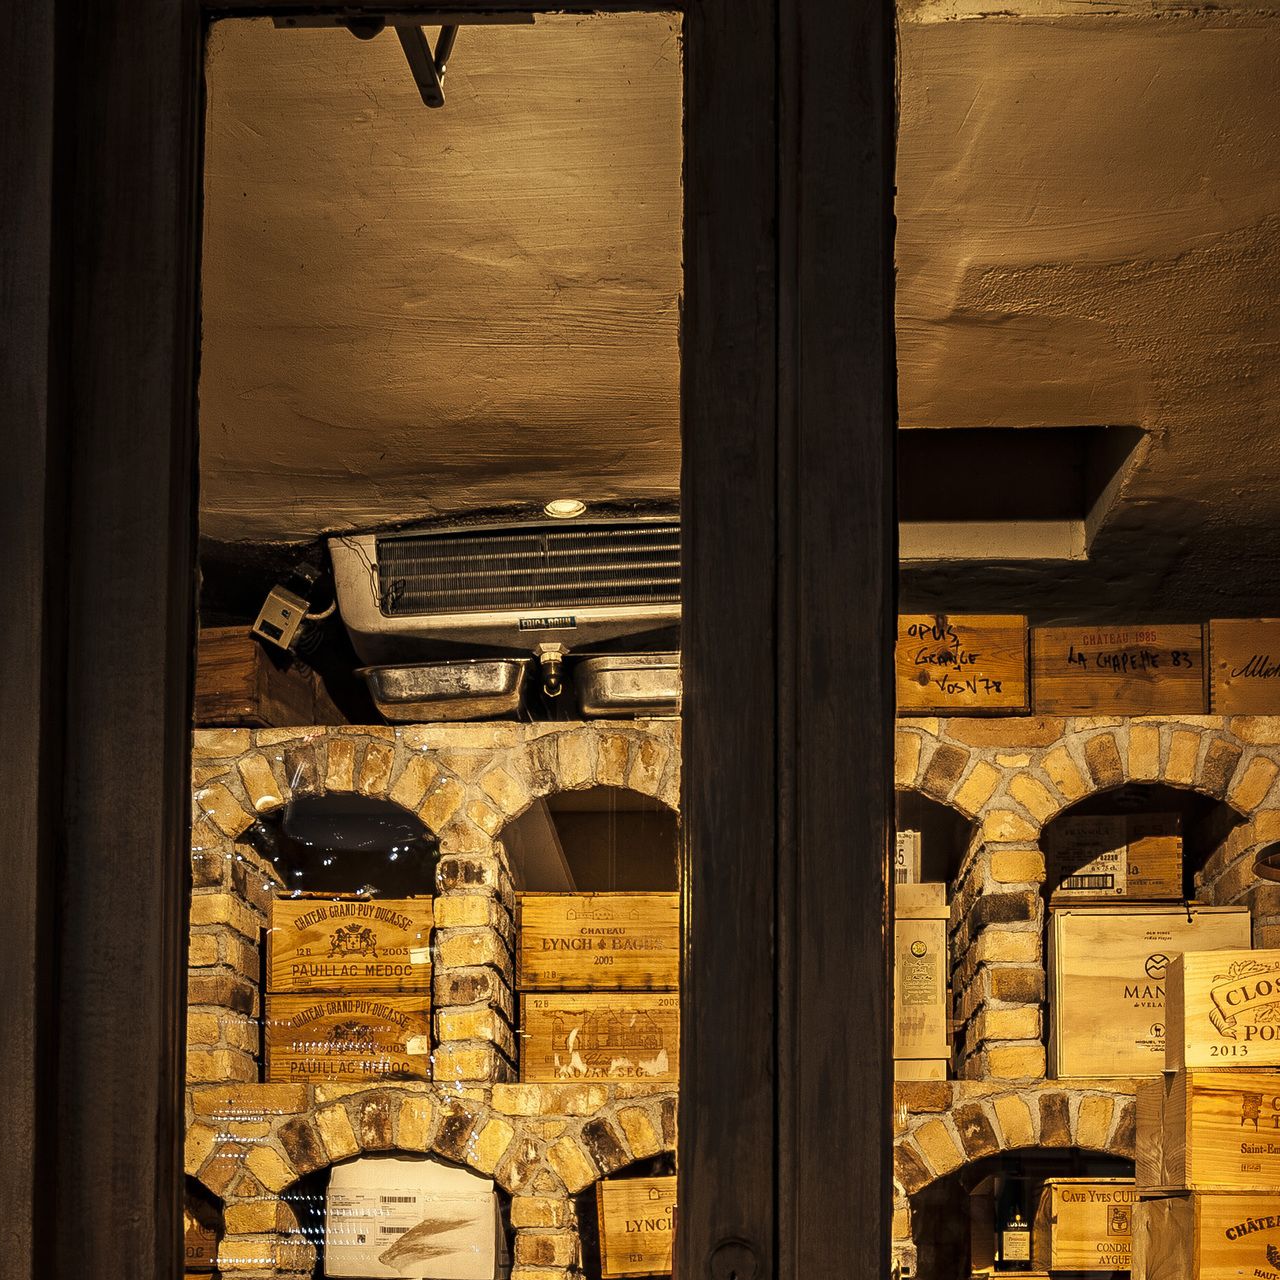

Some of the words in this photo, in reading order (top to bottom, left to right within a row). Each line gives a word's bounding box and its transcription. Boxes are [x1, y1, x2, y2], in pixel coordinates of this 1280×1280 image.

[907, 624, 959, 642] OPUS
[1083, 633, 1129, 646] CHATEAU
[1135, 631, 1157, 642] 1985
[1068, 645, 1088, 670] LA
[1171, 650, 1193, 669] 83
[294, 907, 328, 932] CHATEAU
[329, 904, 356, 918] GRAND
[358, 903, 375, 917] PUY
[375, 906, 413, 932] DUCASSE
[580, 927, 626, 935] CHATEAU
[542, 938, 592, 950] LYNCH
[593, 955, 614, 965] 2003
[292, 964, 358, 977] PAUILLAC
[365, 964, 413, 977] MEDOC
[292, 1004, 324, 1029] CHATEAU
[327, 1001, 353, 1015] GRAND
[355, 1000, 372, 1013] PUY
[372, 1003, 411, 1029] DUCASSE
[1210, 1045, 1249, 1057] 2013
[290, 1061, 355, 1074] PAUILLAC
[363, 1061, 410, 1074] MEDOC
[1098, 1255, 1132, 1264] AYGUE
